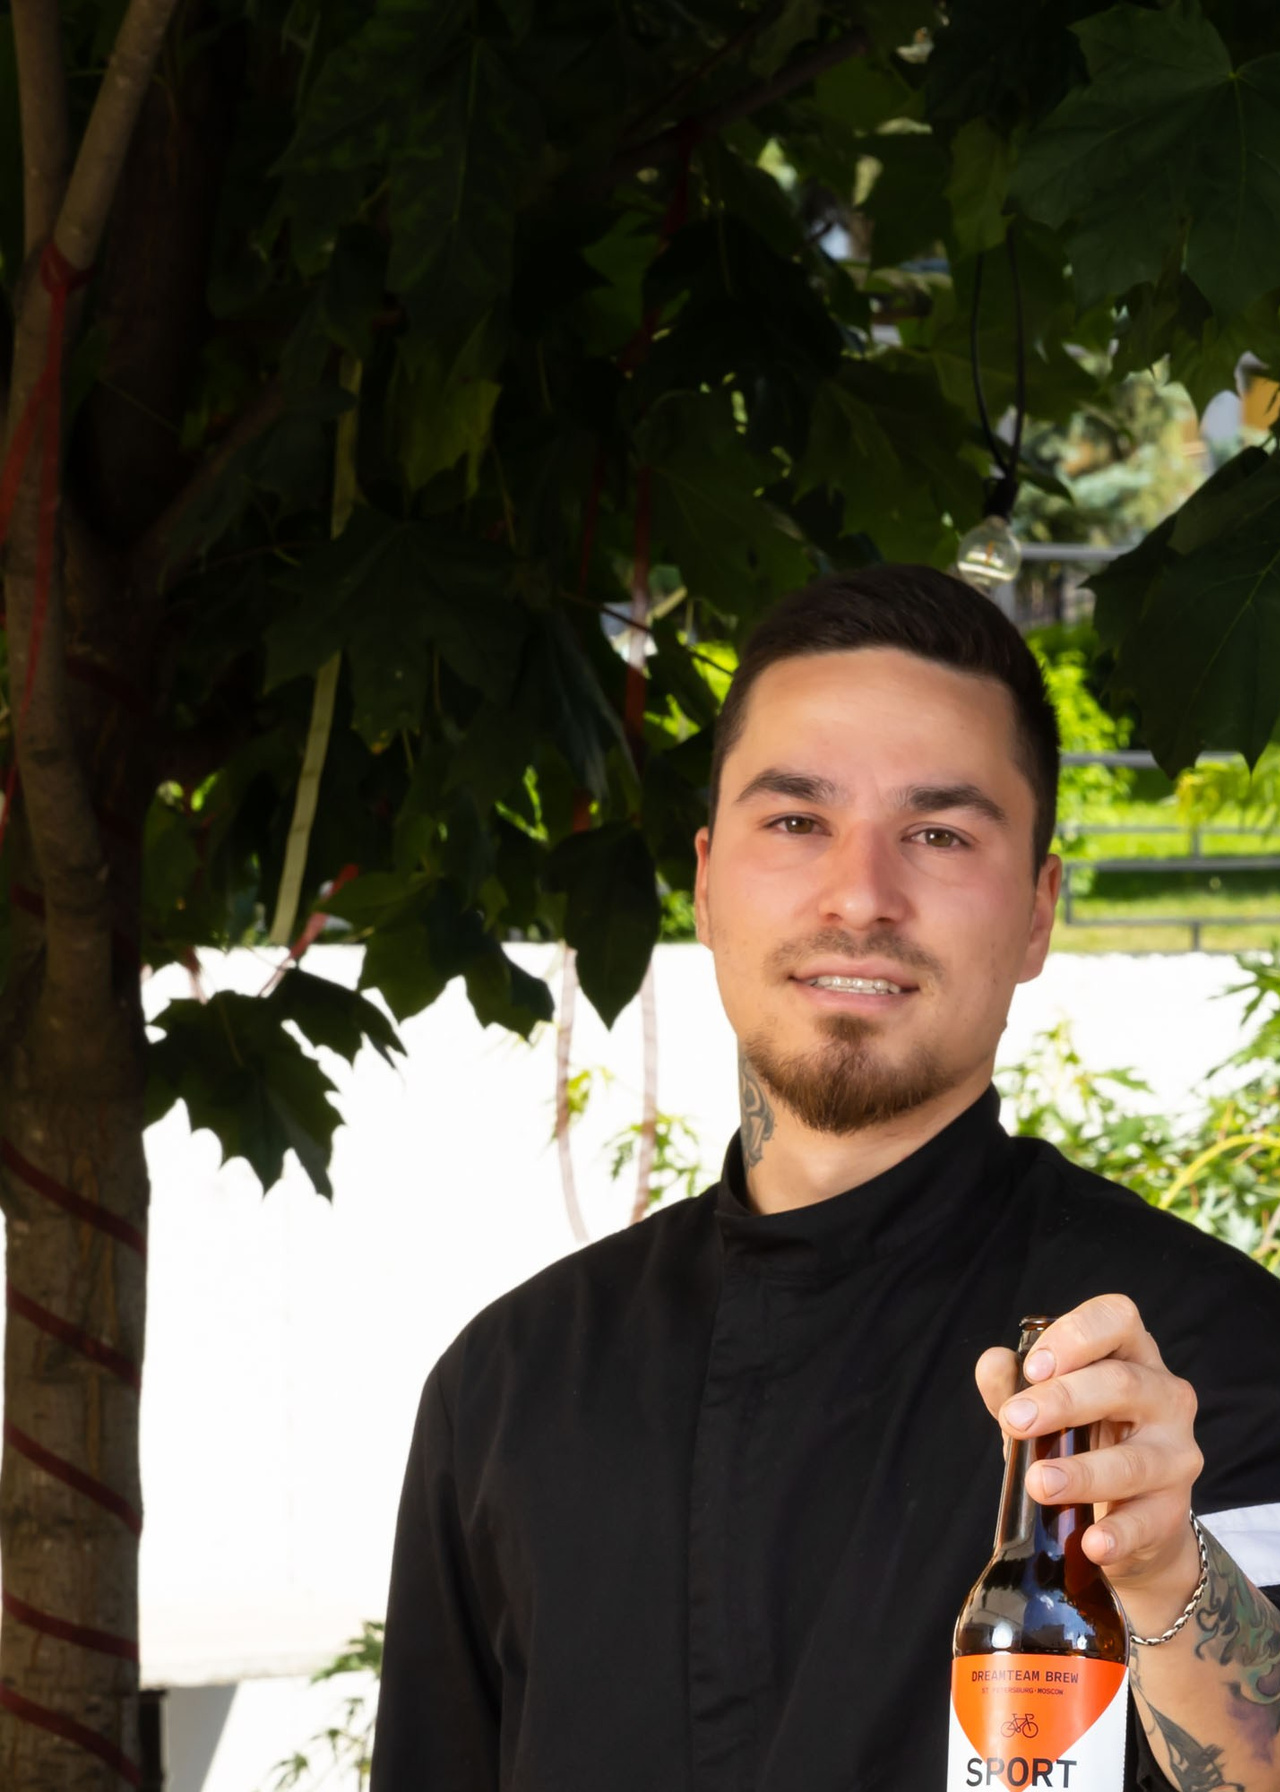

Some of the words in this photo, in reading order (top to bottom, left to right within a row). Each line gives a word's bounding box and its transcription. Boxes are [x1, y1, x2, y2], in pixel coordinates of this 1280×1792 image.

[971, 1669, 1040, 1682] DREAMTEAM
[1045, 1670, 1079, 1684] BREW
[966, 1756, 1077, 1788] SPORT
